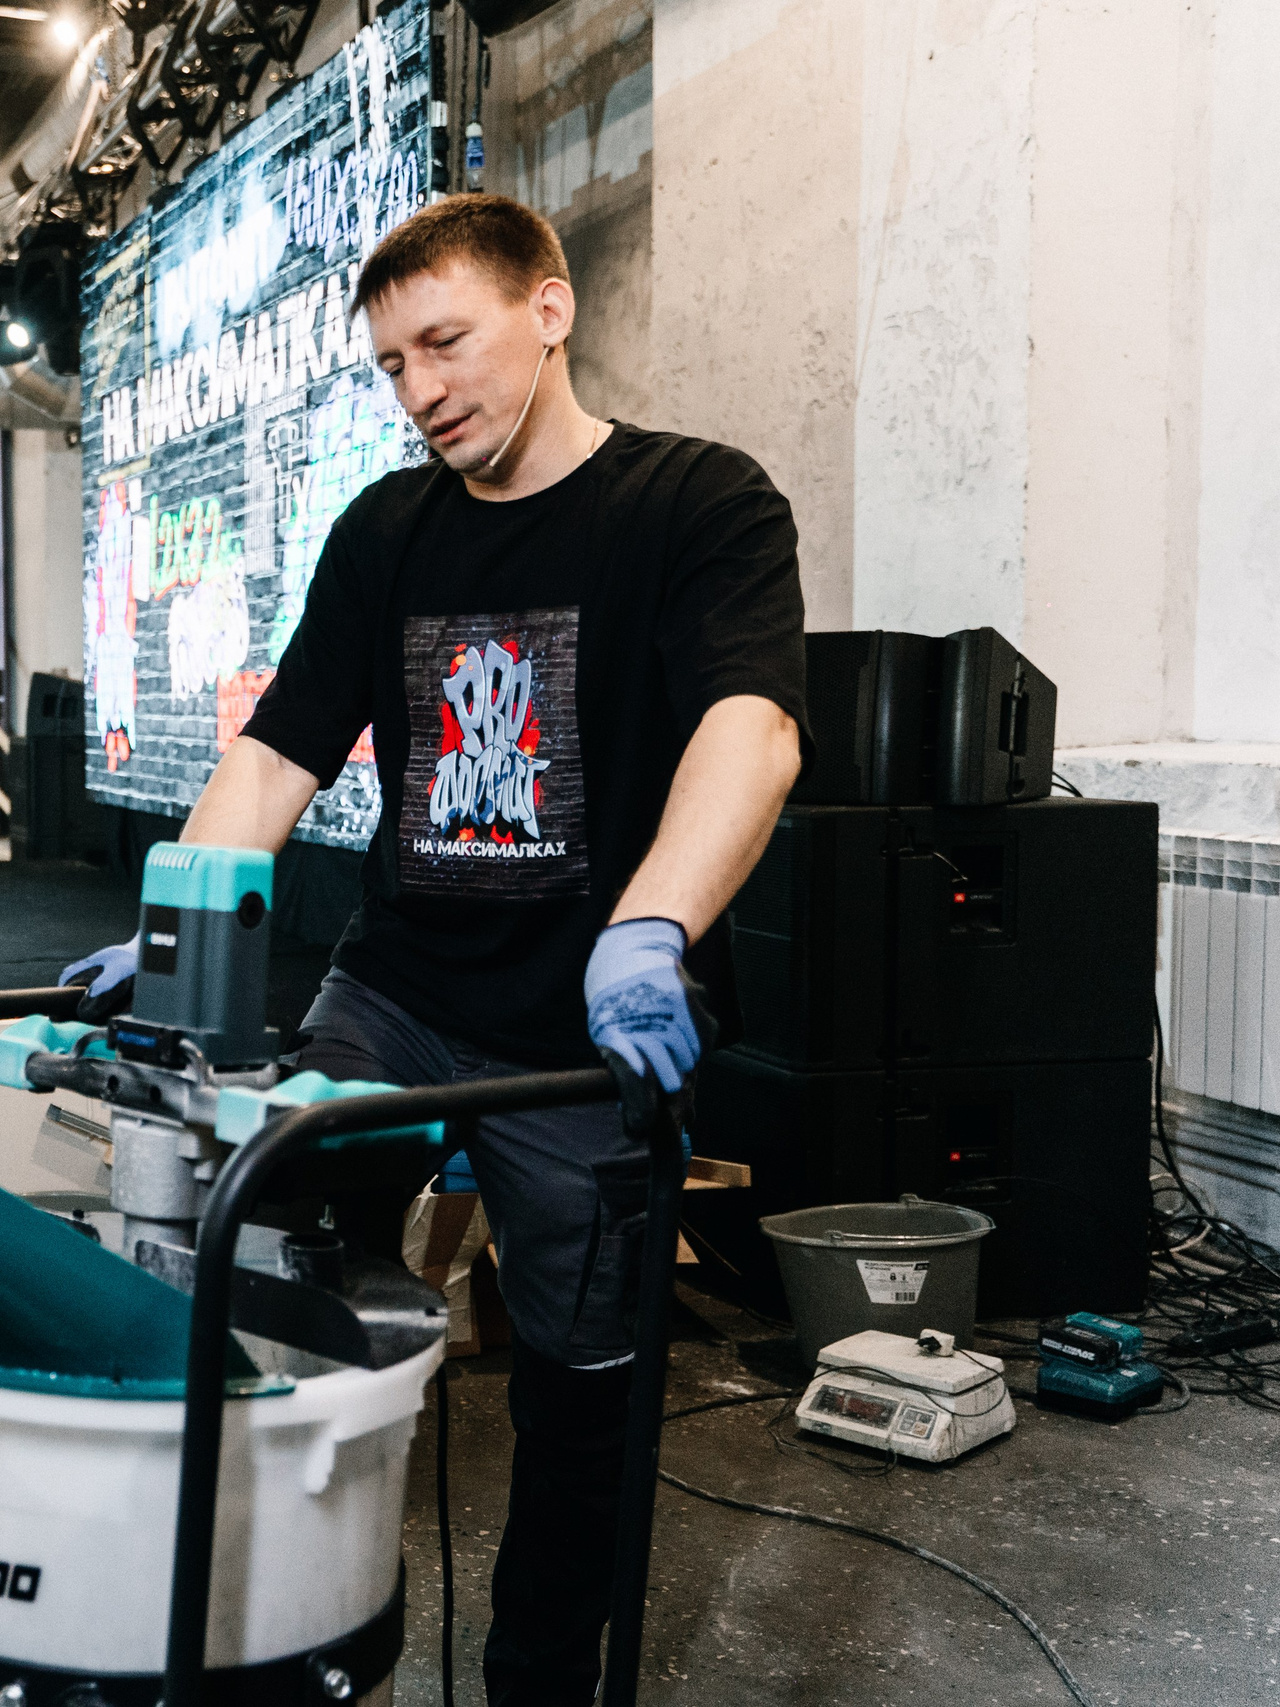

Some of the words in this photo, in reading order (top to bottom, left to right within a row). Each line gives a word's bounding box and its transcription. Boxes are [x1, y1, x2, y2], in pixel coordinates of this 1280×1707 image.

[102, 385, 138, 465] НА
[413, 839, 434, 855] НА
[437, 841, 567, 858] МАКСИМАЛКАХ
